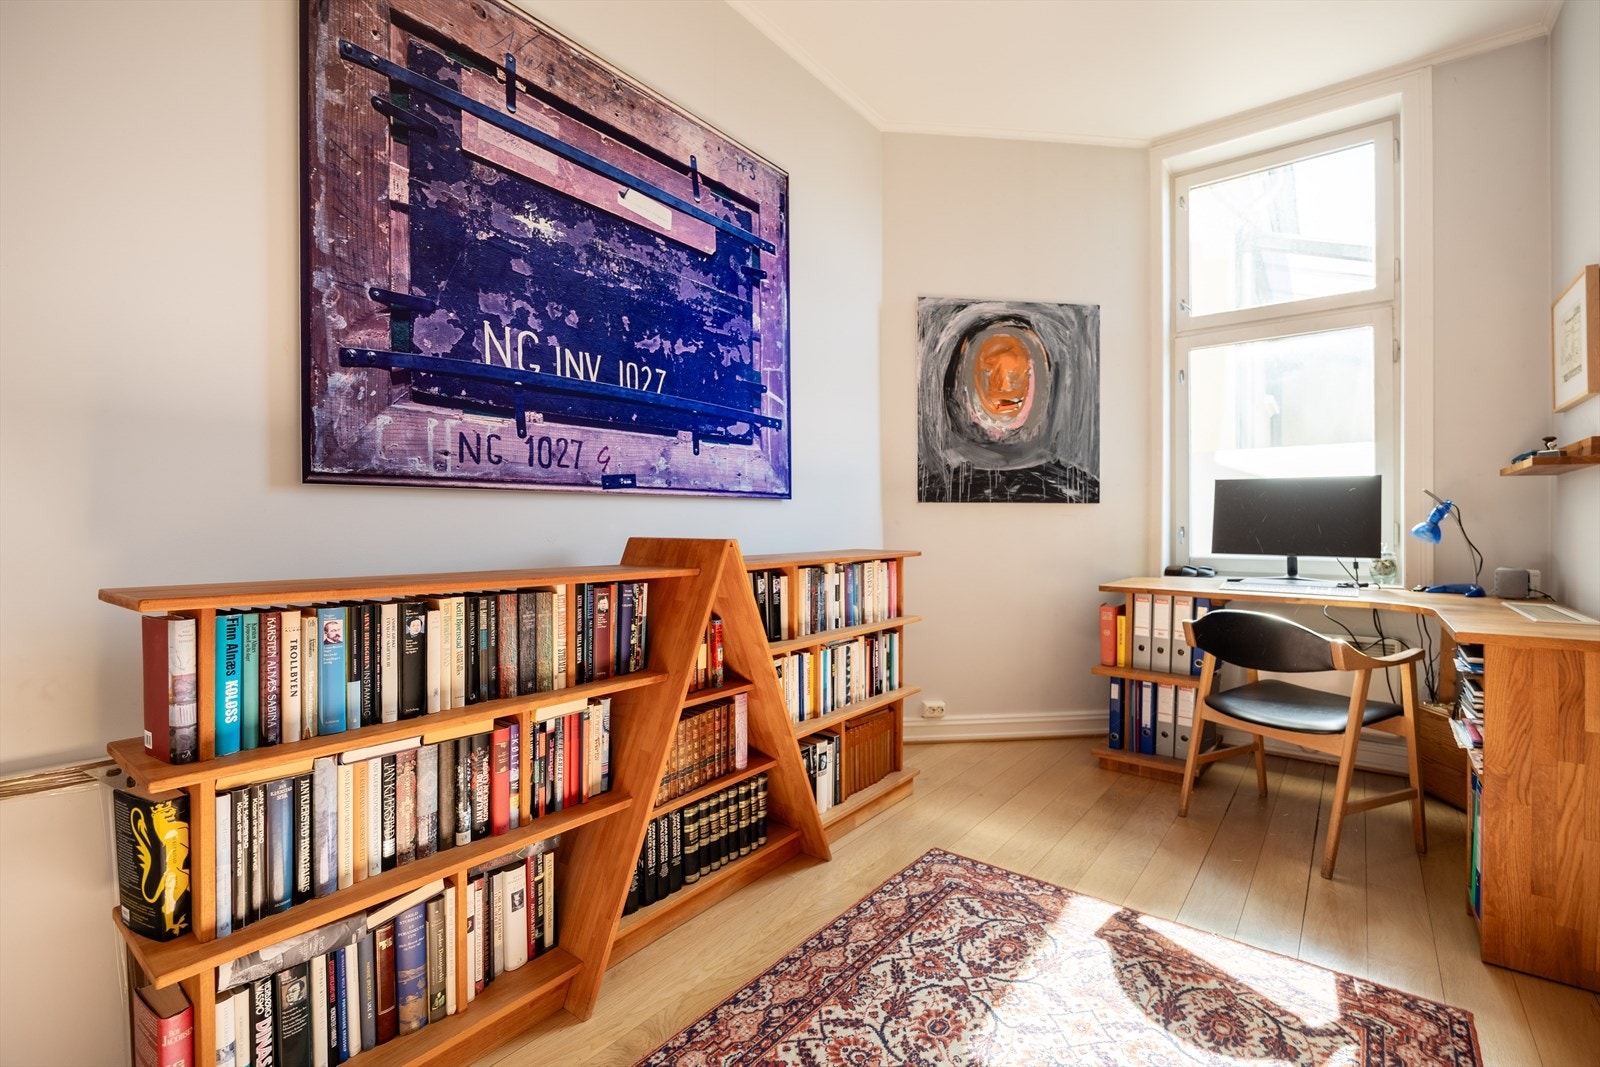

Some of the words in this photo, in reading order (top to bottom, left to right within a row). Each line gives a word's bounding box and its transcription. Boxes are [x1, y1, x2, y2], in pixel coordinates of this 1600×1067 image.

[555, 347, 602, 382] INV
[619, 360, 666, 394] 1027
[458, 432, 502, 466] NG
[525, 436, 583, 470] 1027
[455, 602, 463, 617] Ketil
[226, 618, 239, 640] Finn
[267, 617, 276, 658] KARSTEN
[455, 618, 463, 648] Bjørnstad
[226, 644, 239, 676] Alnæs
[267, 660, 276, 692] ALNÆS
[290, 639, 298, 698] TROLLBYEN
[267, 694, 276, 728] SABINA
[301, 780, 309, 794] JAN
[384, 762, 395, 782] JAN
[301, 840, 309, 861] HOMO
